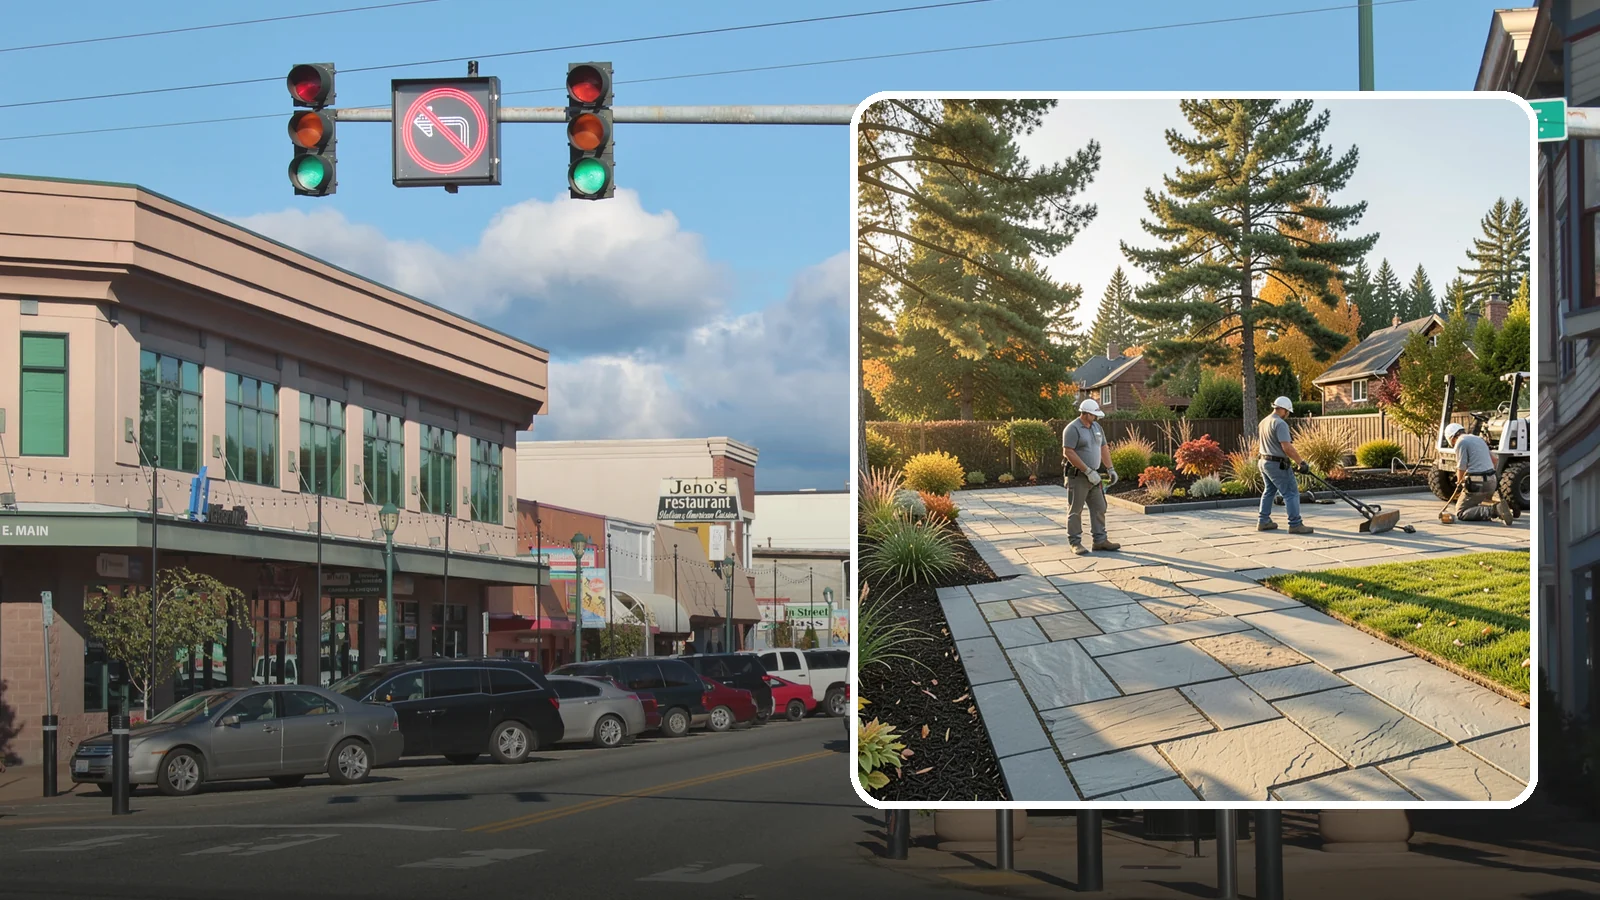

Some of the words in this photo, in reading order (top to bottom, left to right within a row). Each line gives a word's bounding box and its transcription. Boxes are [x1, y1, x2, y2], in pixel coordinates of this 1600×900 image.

[670, 480, 727, 494] Jeno's
[665, 496, 730, 509] restaurant
[658, 510, 681, 519] Italian
[686, 509, 714, 519] American
[715, 510, 737, 519] Cuisine
[2, 525, 13, 536] E.
[15, 525, 49, 536] MAIN
[797, 607, 828, 617] Street
[790, 619, 823, 627] lass
